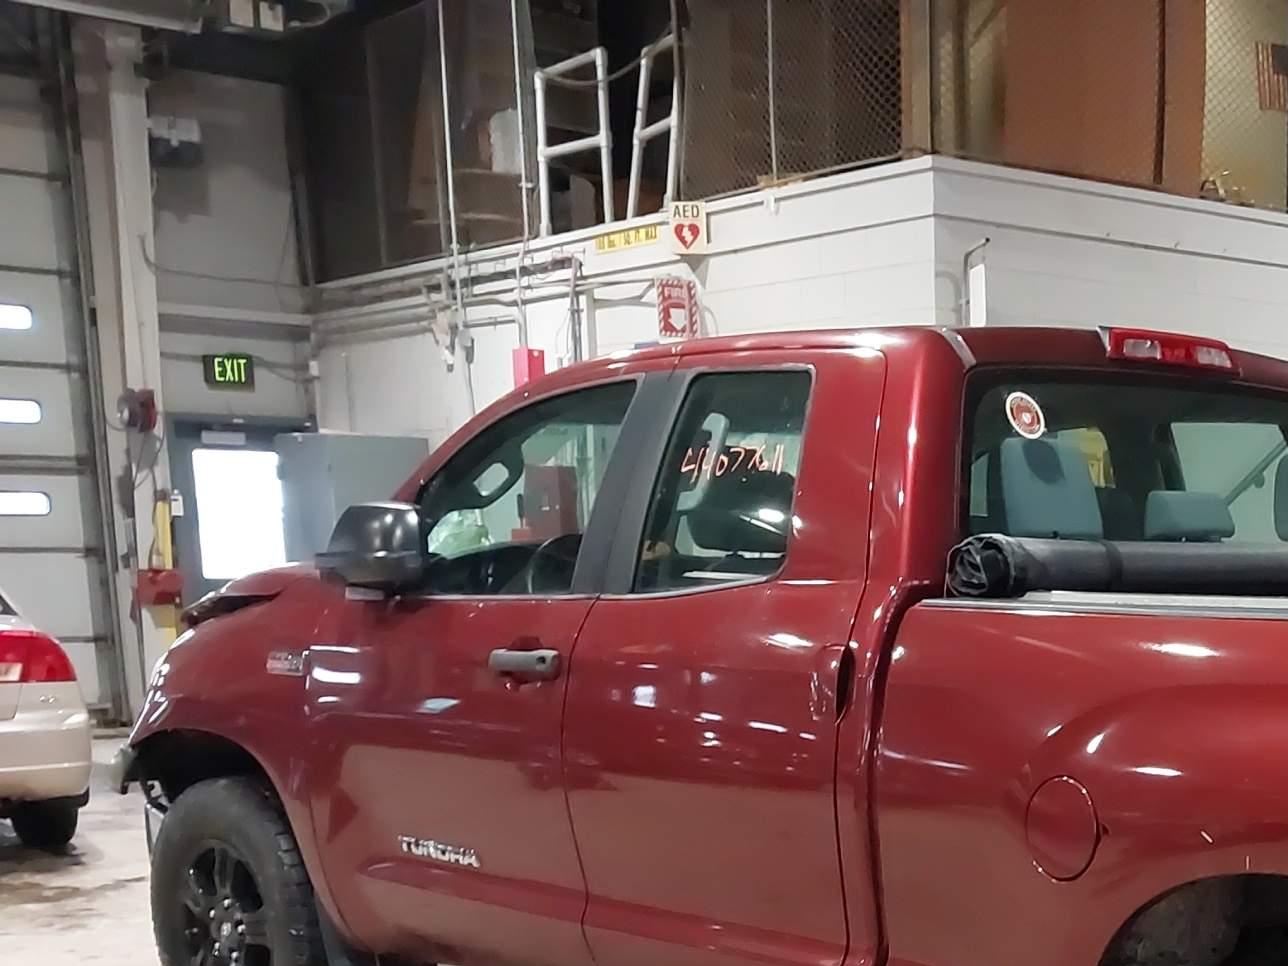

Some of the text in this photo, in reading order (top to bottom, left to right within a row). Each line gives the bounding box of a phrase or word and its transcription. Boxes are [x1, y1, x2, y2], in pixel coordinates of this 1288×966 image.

[673, 205, 700, 218] AED
[214, 357, 247, 383] EXIT
[680, 443, 785, 484] 44077611
[398, 834, 480, 868] TUNDRA
